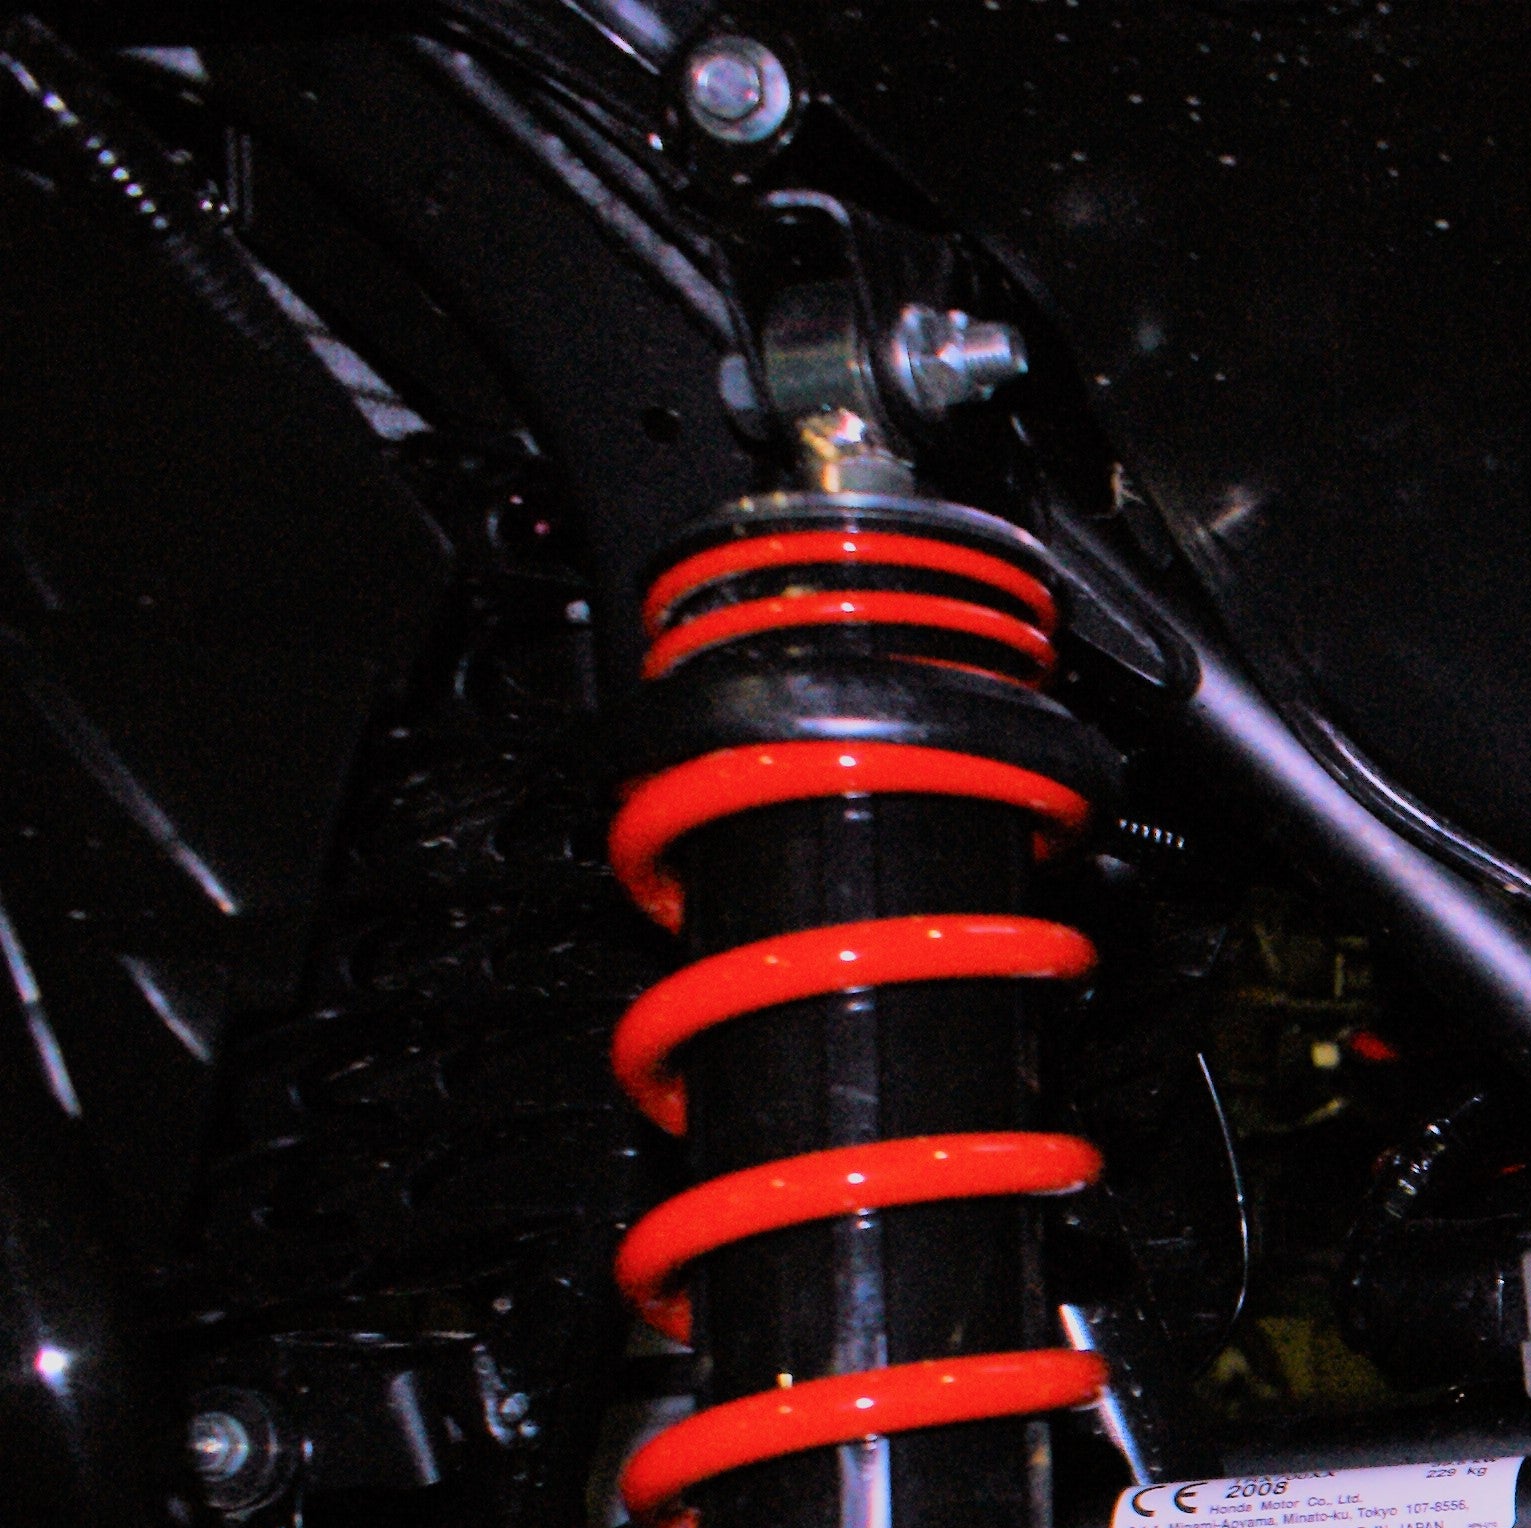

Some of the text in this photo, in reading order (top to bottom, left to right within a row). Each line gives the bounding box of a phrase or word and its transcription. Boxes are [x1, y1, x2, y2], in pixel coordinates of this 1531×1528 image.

[1426, 1468, 1457, 1479] 229
[1225, 1481, 1289, 1499] 2008
[1209, 1503, 1253, 1515] Honda
[1261, 1500, 1300, 1511] Motor
[1358, 1507, 1399, 1520] Tokyo
